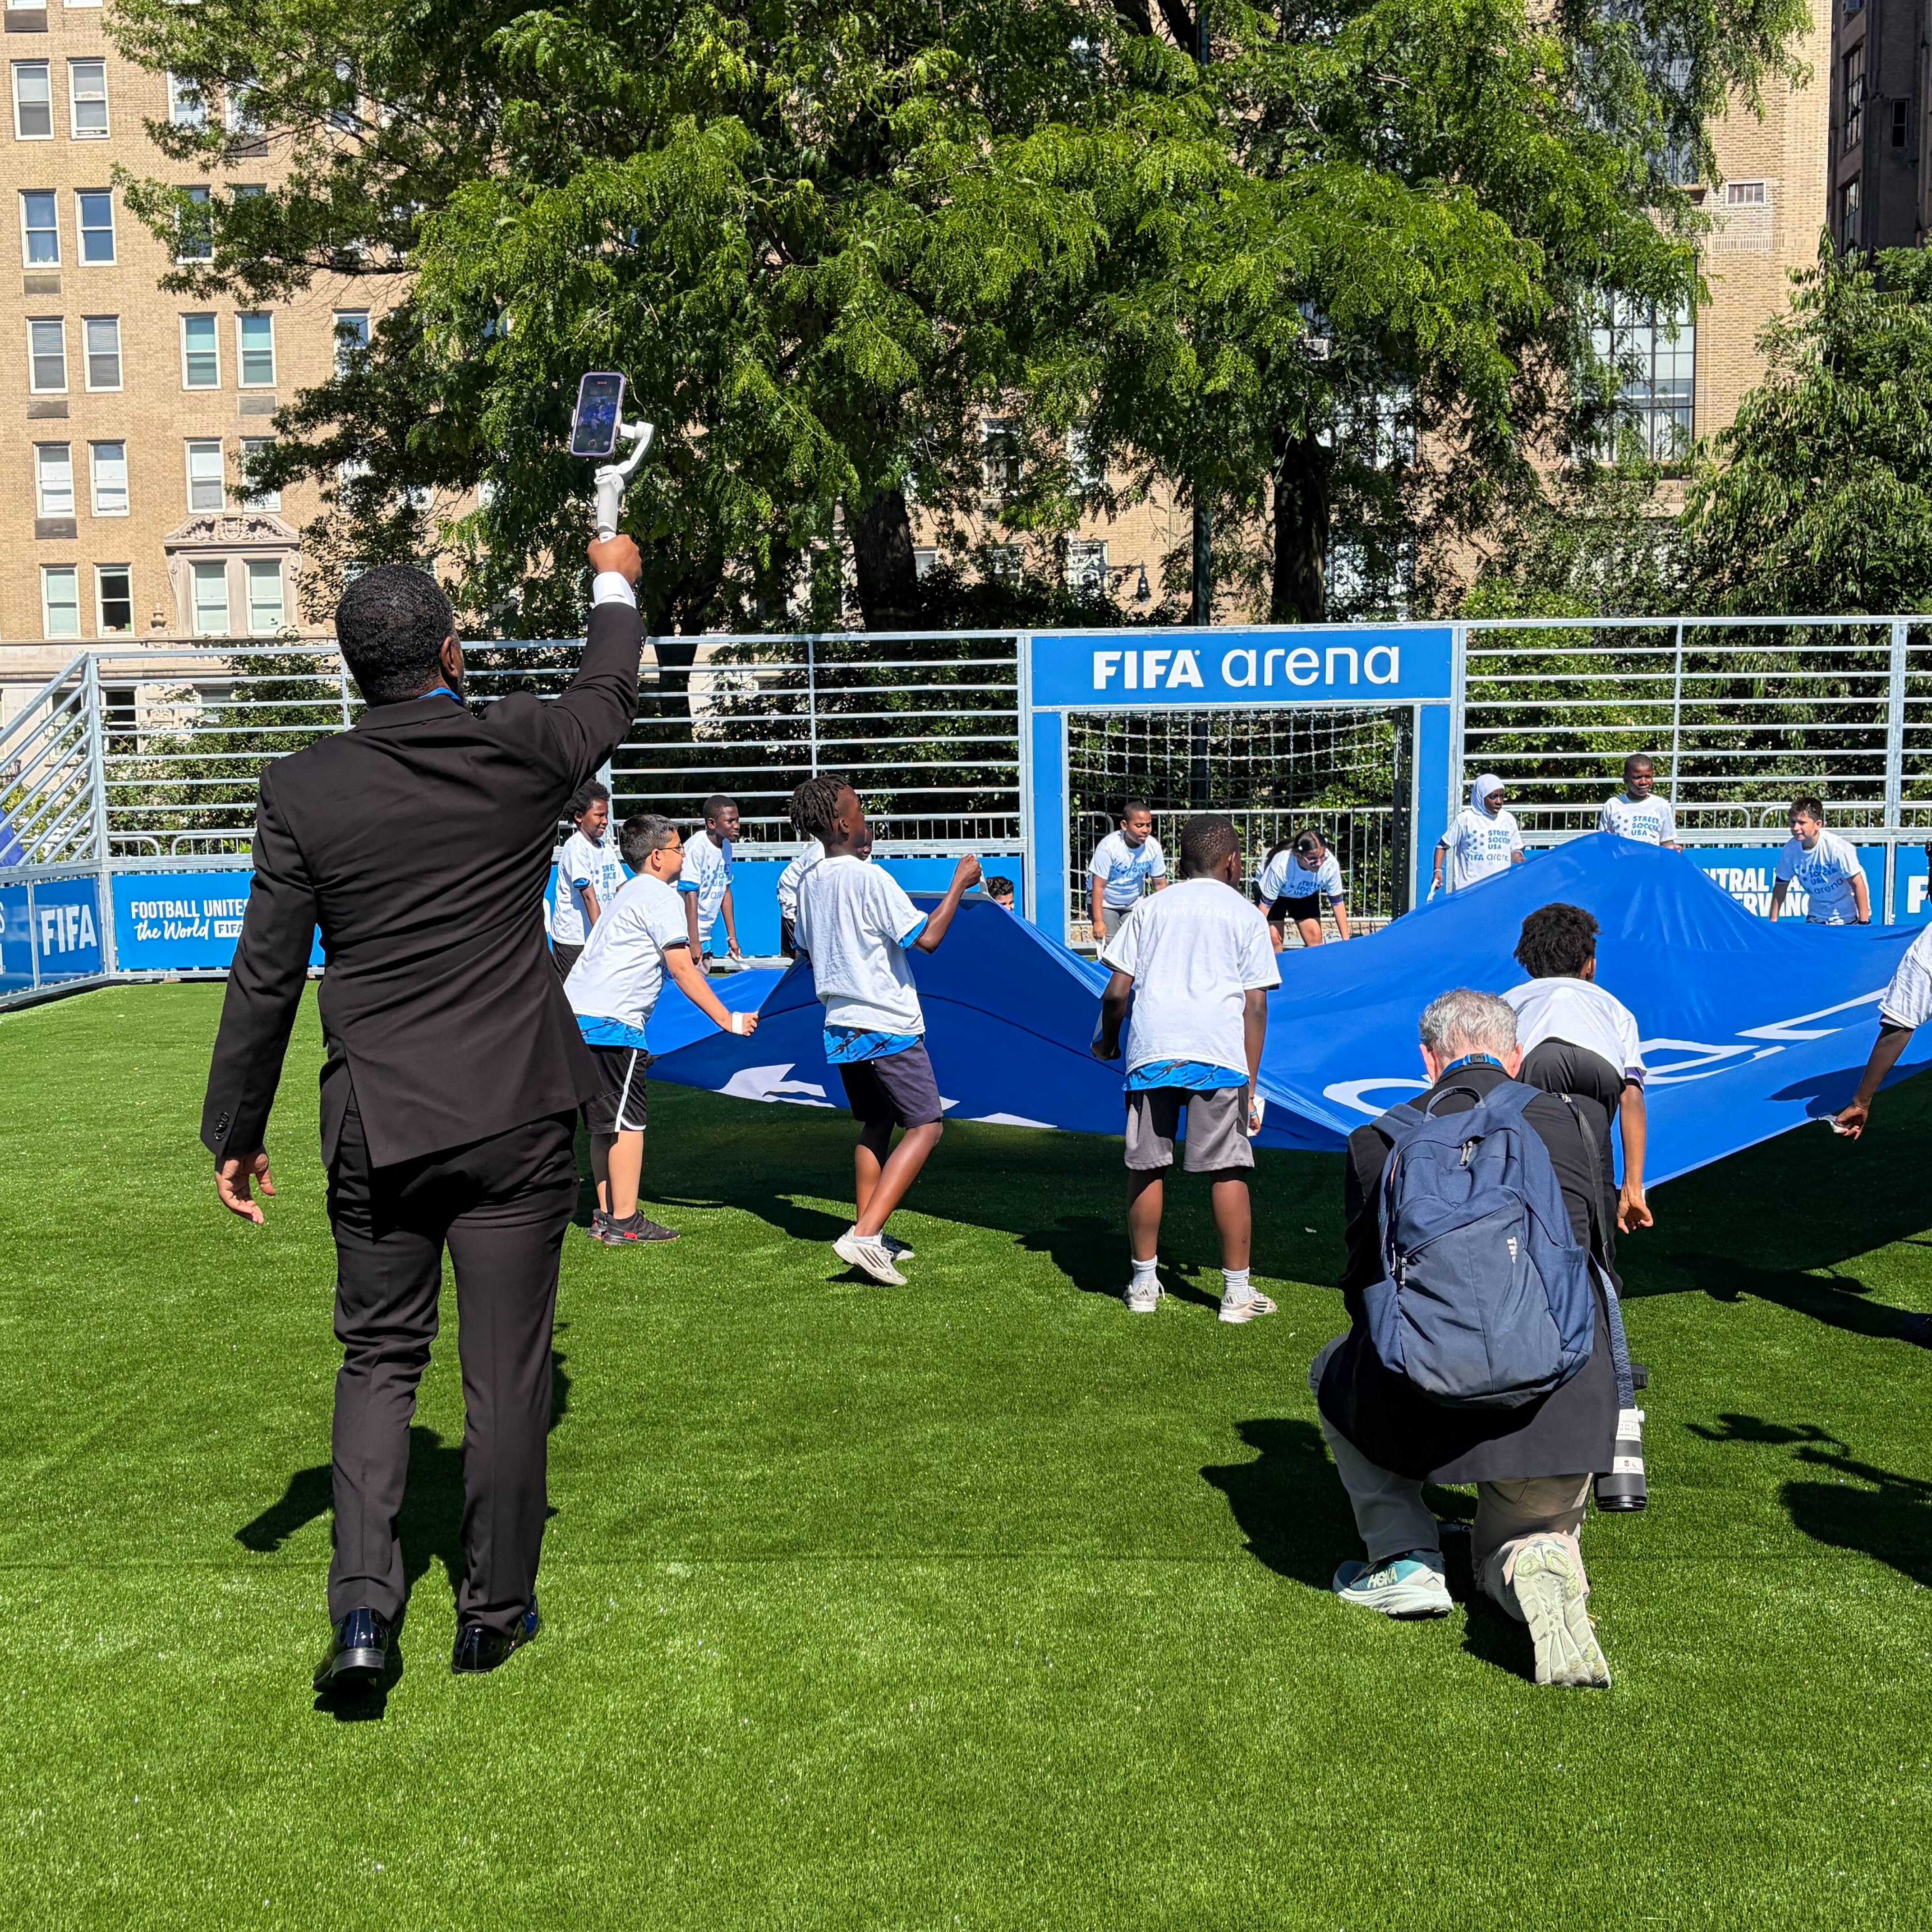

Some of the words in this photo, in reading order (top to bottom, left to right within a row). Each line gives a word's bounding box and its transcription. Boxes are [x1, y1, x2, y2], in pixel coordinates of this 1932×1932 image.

[1093, 649, 1205, 690] FIFA
[1221, 646, 1399, 687] arena
[1813, 878, 1844, 894] arena
[131, 900, 200, 919] FOOTBALL
[41, 905, 97, 956] FIFA
[133, 920, 161, 941] the
[163, 917, 210, 941] World
[1367, 1566, 1398, 1589] HOKA
